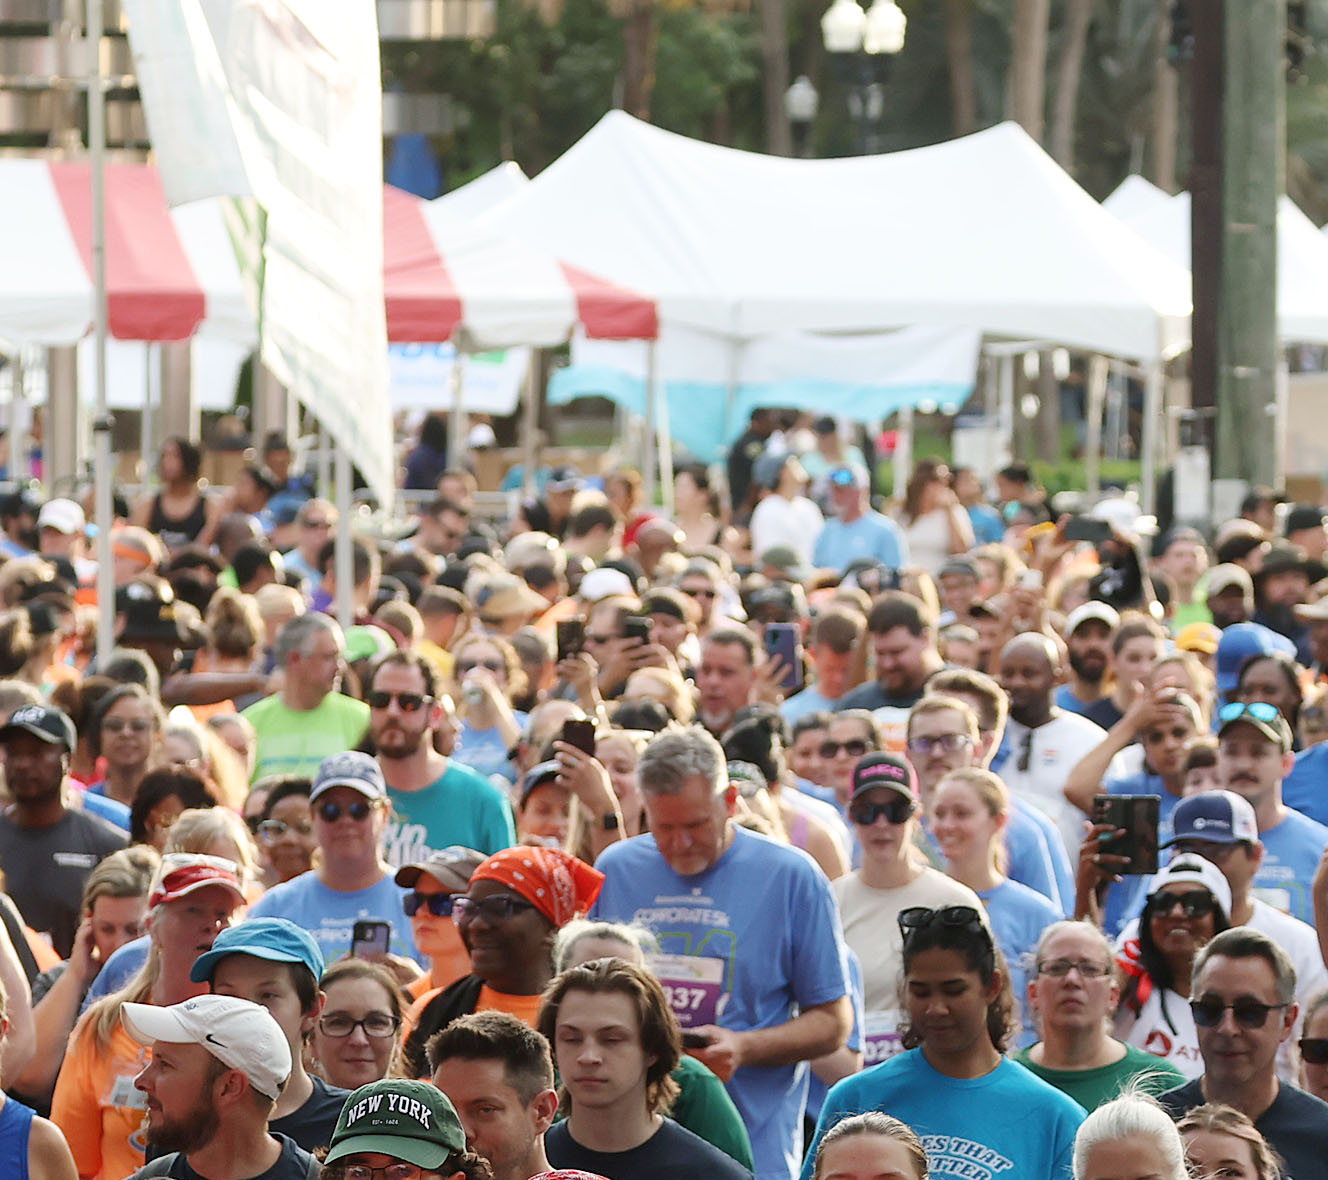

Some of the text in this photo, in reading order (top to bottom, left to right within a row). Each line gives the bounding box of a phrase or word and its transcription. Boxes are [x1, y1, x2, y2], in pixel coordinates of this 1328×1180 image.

[347, 1093, 432, 1130] NEW YORK
[952, 1136, 1013, 1171] THAT
